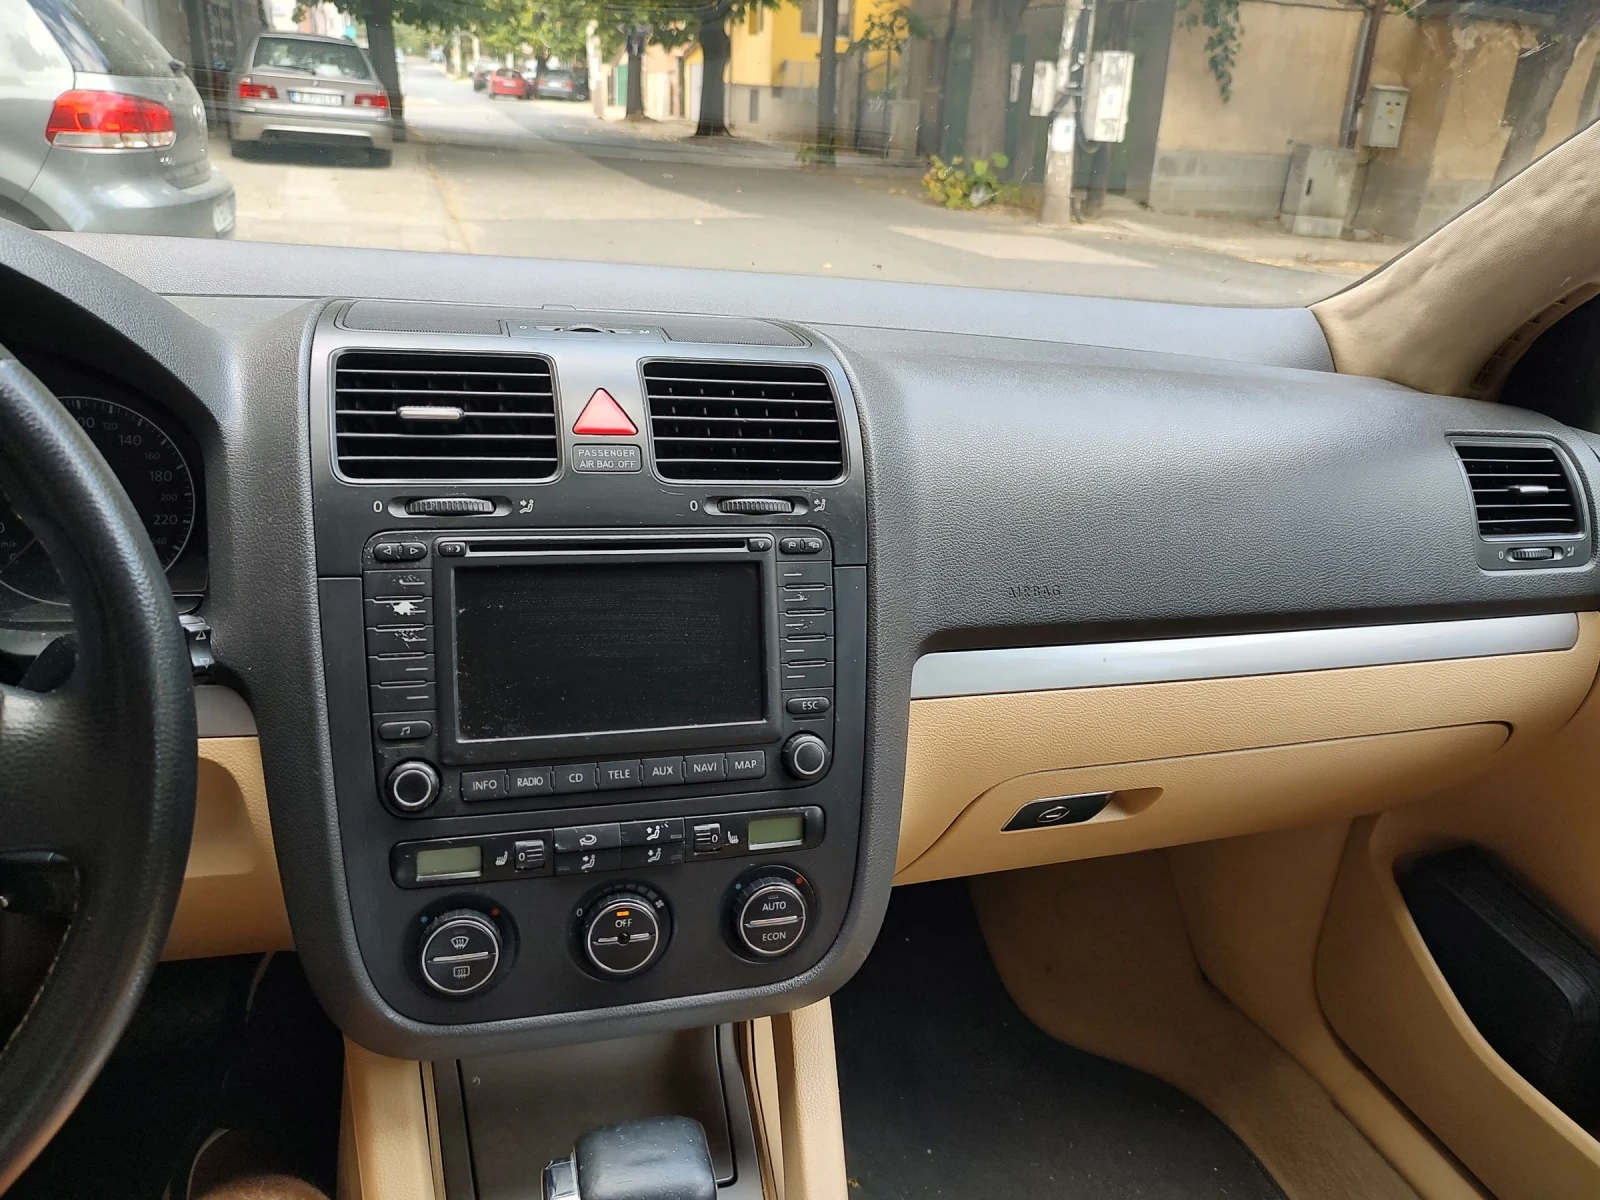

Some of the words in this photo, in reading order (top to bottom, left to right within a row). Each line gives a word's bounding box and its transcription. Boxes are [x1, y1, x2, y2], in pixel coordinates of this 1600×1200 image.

[77, 417, 95, 428] 00
[102, 422, 118, 430] 120
[119, 434, 142, 446] 140
[144, 452, 160, 460] 160
[578, 449, 636, 457] PASSENGER
[149, 470, 172, 481] 180
[160, 493, 178, 501] 200
[373, 500, 383, 513] 0
[689, 500, 699, 512] 0
[153, 514, 178, 525] 220
[1009, 584, 1061, 598] AIRBAG
[802, 700, 819, 710] ESC
[693, 762, 717, 773] NAVI
[734, 759, 758, 770] MAP
[608, 769, 631, 780] TELE
[652, 765, 674, 776] AUX
[517, 776, 544, 787] RADIO
[568, 773, 584, 783] CD
[472, 779, 497, 791] INFO
[711, 834, 719, 843] 0
[518, 852, 526, 861] 0
[762, 900, 787, 912] AUTO
[615, 918, 632, 928] OFF
[762, 931, 787, 942] ECON
